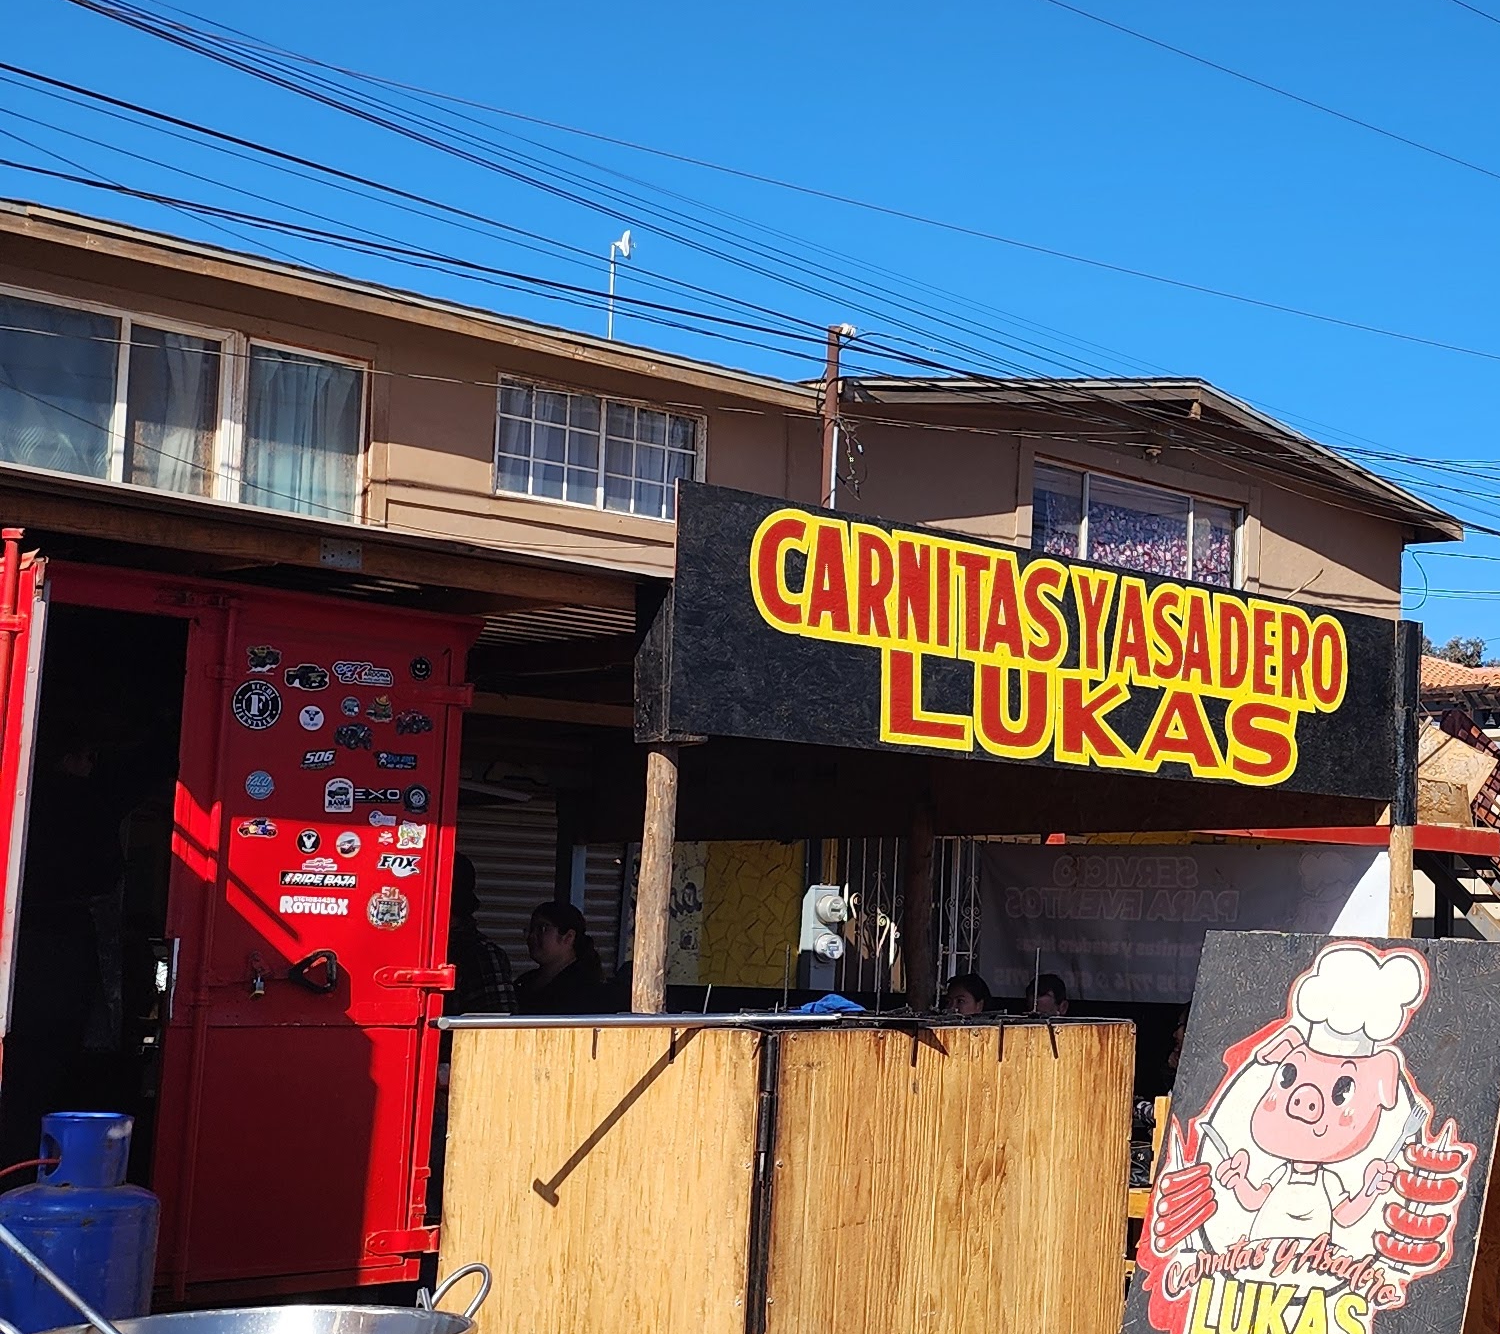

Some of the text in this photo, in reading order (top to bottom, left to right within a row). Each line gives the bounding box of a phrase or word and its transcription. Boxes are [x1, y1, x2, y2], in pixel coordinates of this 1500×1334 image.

[751, 510, 1348, 714] CARNITAS Y ASADERO
[249, 694, 266, 716] F
[881, 649, 1297, 786] LUKAS
[304, 751, 335, 763] 506
[354, 788, 400, 800] EXO
[380, 855, 419, 869] FOX
[294, 873, 325, 884] RIDE
[325, 874, 356, 886] BAJA
[1165, 1234, 1271, 1298] Carnitas
